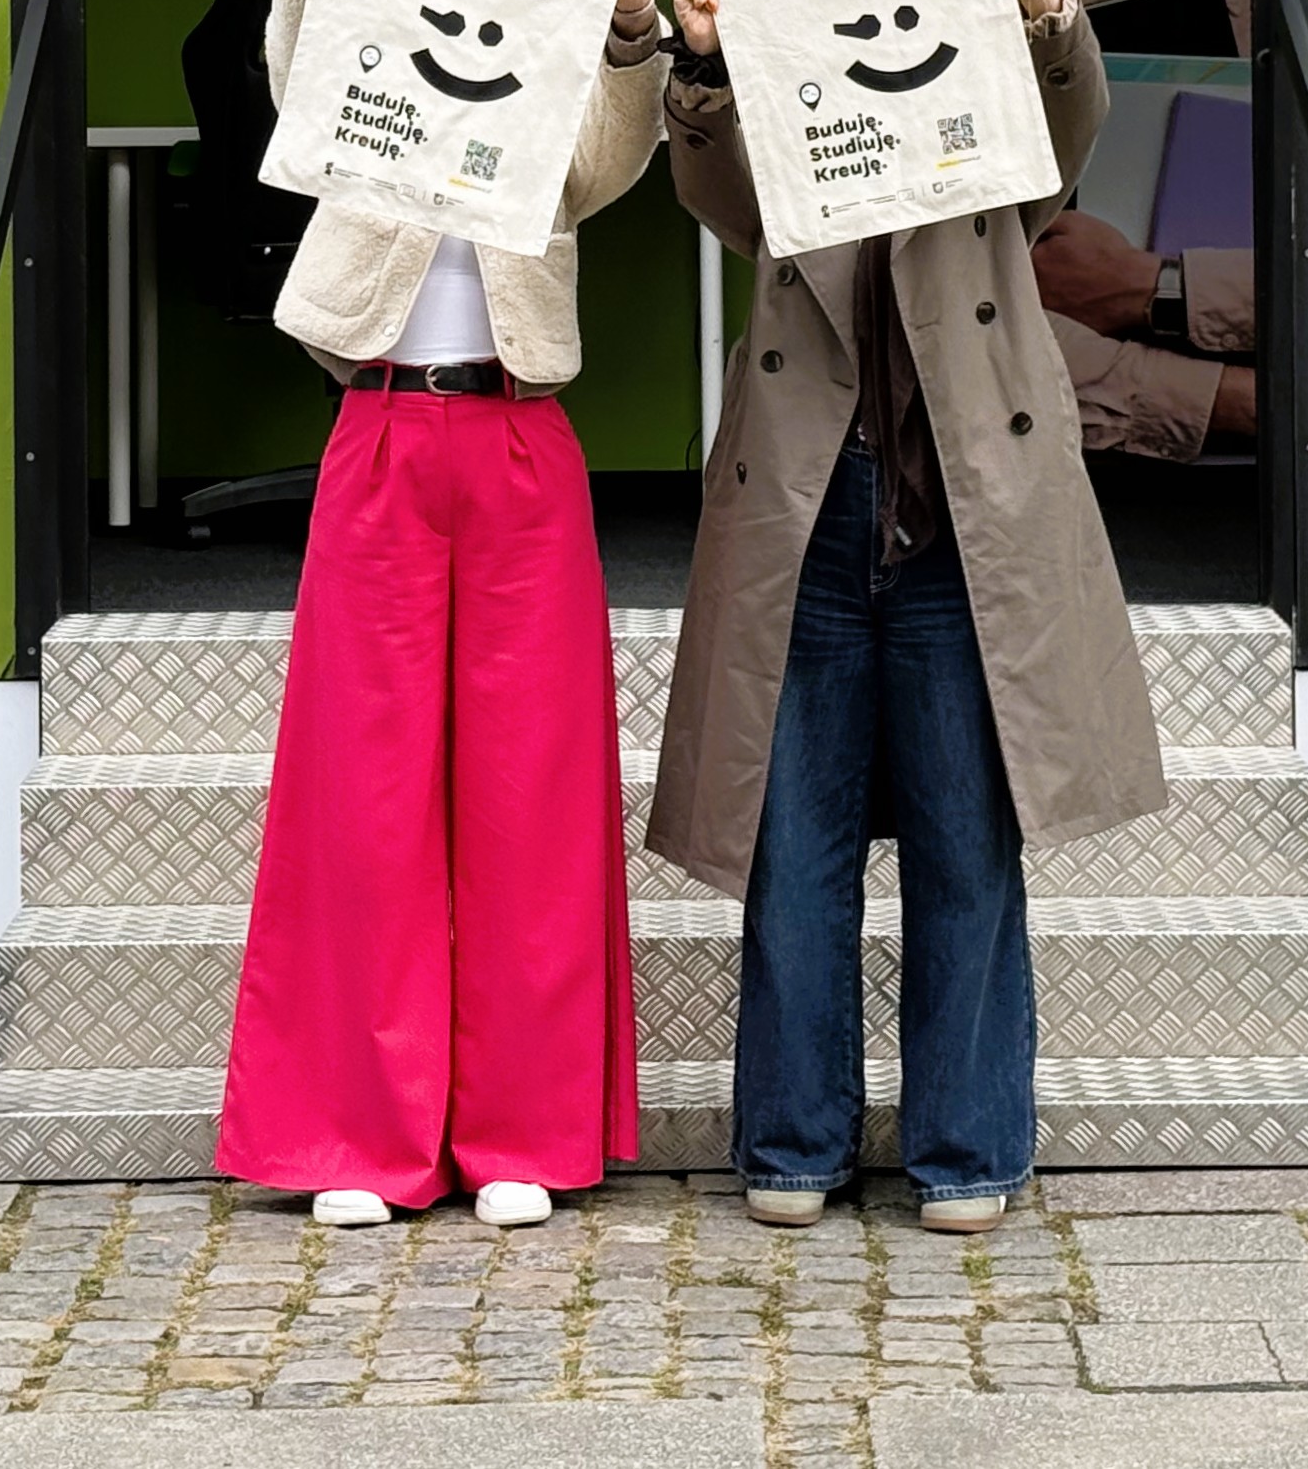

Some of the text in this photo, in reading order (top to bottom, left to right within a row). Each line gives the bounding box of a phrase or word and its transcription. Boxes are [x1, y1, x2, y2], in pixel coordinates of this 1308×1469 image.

[346, 84, 421, 120] Buduję.
[341, 106, 428, 145] Studiuję.
[805, 113, 883, 141] Buduję.
[335, 126, 405, 161] Kreuję.
[809, 131, 901, 162] Studiuję.
[814, 156, 888, 184] Kreuję.
